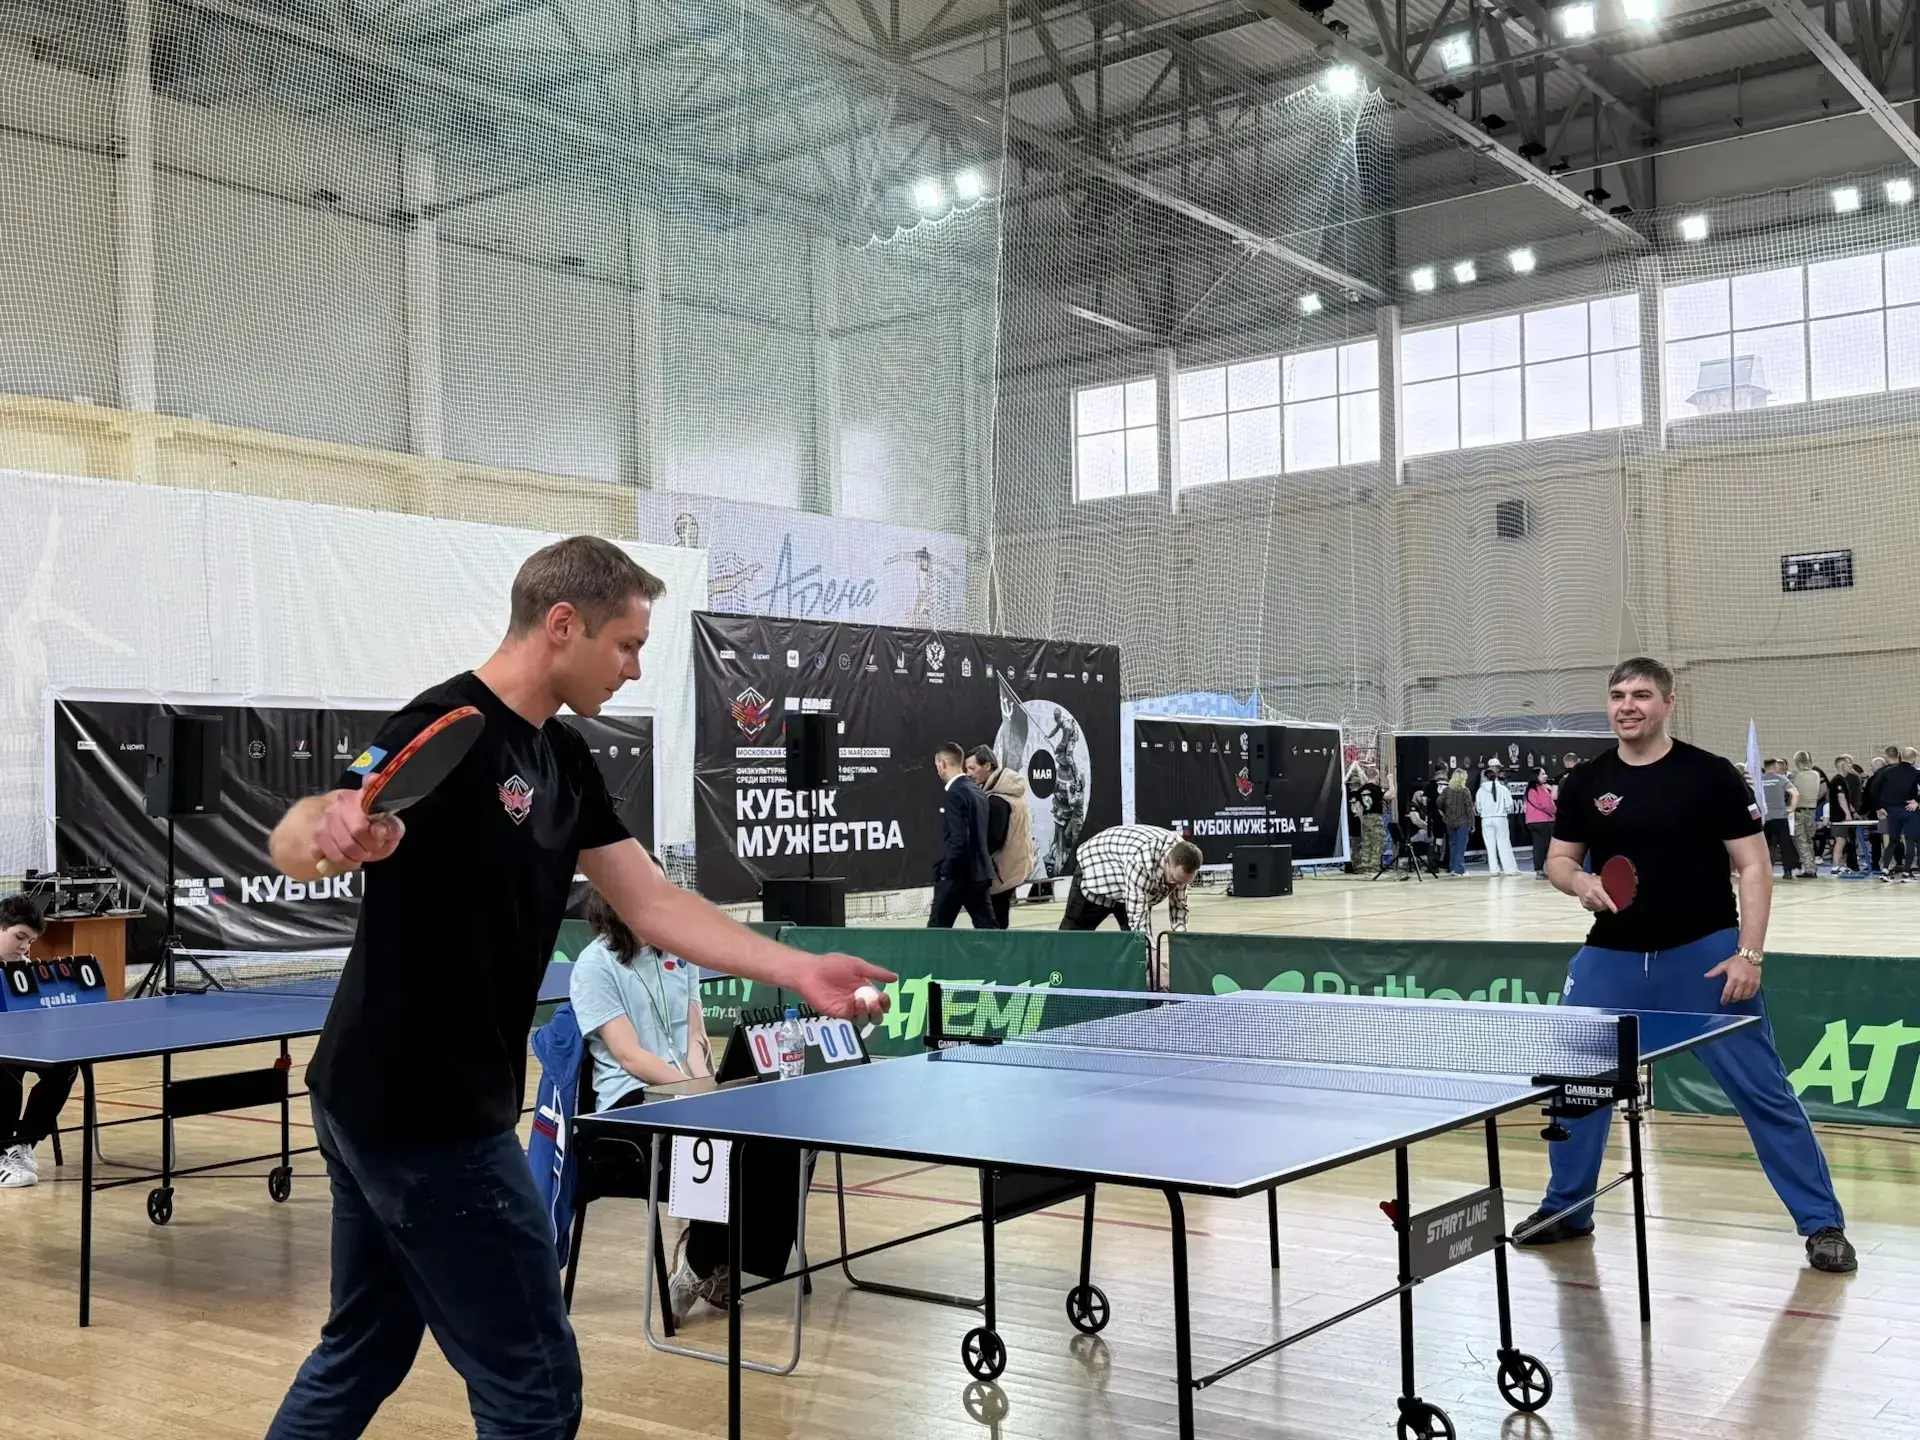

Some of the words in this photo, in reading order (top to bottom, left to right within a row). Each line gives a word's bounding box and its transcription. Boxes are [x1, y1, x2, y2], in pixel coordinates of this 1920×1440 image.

[736, 775, 758, 783] СРЕДИ
[759, 775, 787, 783] ВЕТЕРАН
[838, 774, 854, 782] ТВИЙ
[1033, 769, 1052, 780] МАЯ
[736, 788, 838, 820] КУБОК
[737, 820, 904, 858] МУЖЕСТВА
[1193, 819, 1232, 836] КУБОК
[1233, 818, 1296, 835] МУЖЕСТВА
[241, 872, 354, 904] КУБОК
[14, 970, 29, 993] 0
[39, 965, 49, 979] 0
[59, 963, 70, 977] 0
[81, 965, 96, 987] 0
[1787, 1018, 1920, 1110] AT
[1565, 1084, 1613, 1098] GAMBLER
[1565, 1097, 1598, 1106] BATTLE
[692, 1138, 713, 1184] 9
[1427, 1210, 1465, 1244] START
[1466, 1200, 1490, 1227] LINE
[1448, 1236, 1473, 1260] OLYMPIC
